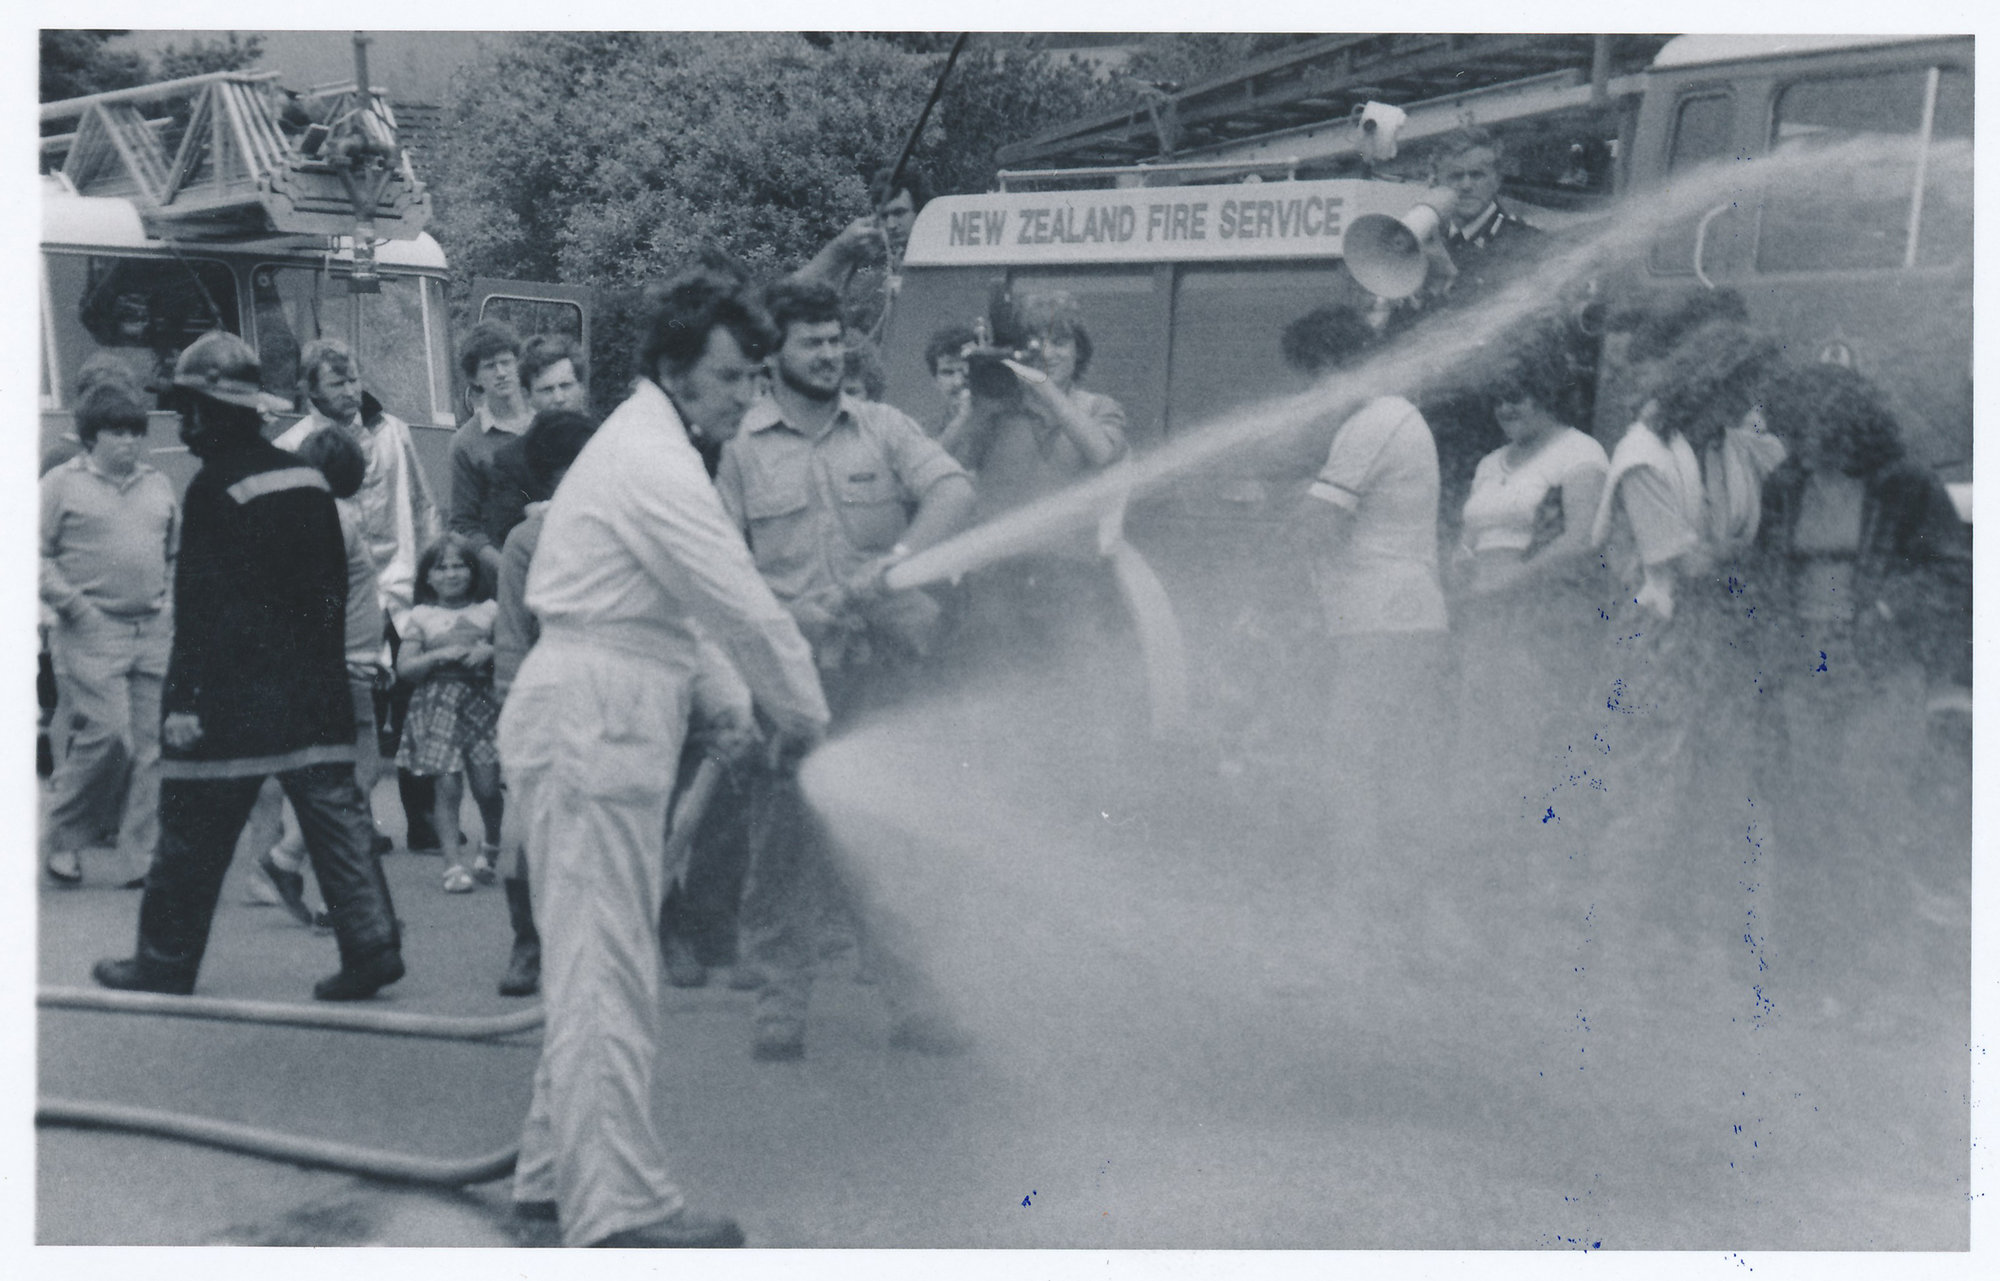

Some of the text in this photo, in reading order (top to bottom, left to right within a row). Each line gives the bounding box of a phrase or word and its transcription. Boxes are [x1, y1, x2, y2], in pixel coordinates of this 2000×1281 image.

[949, 197, 1344, 247] NEW ZEALAND FIRE SERVICE
